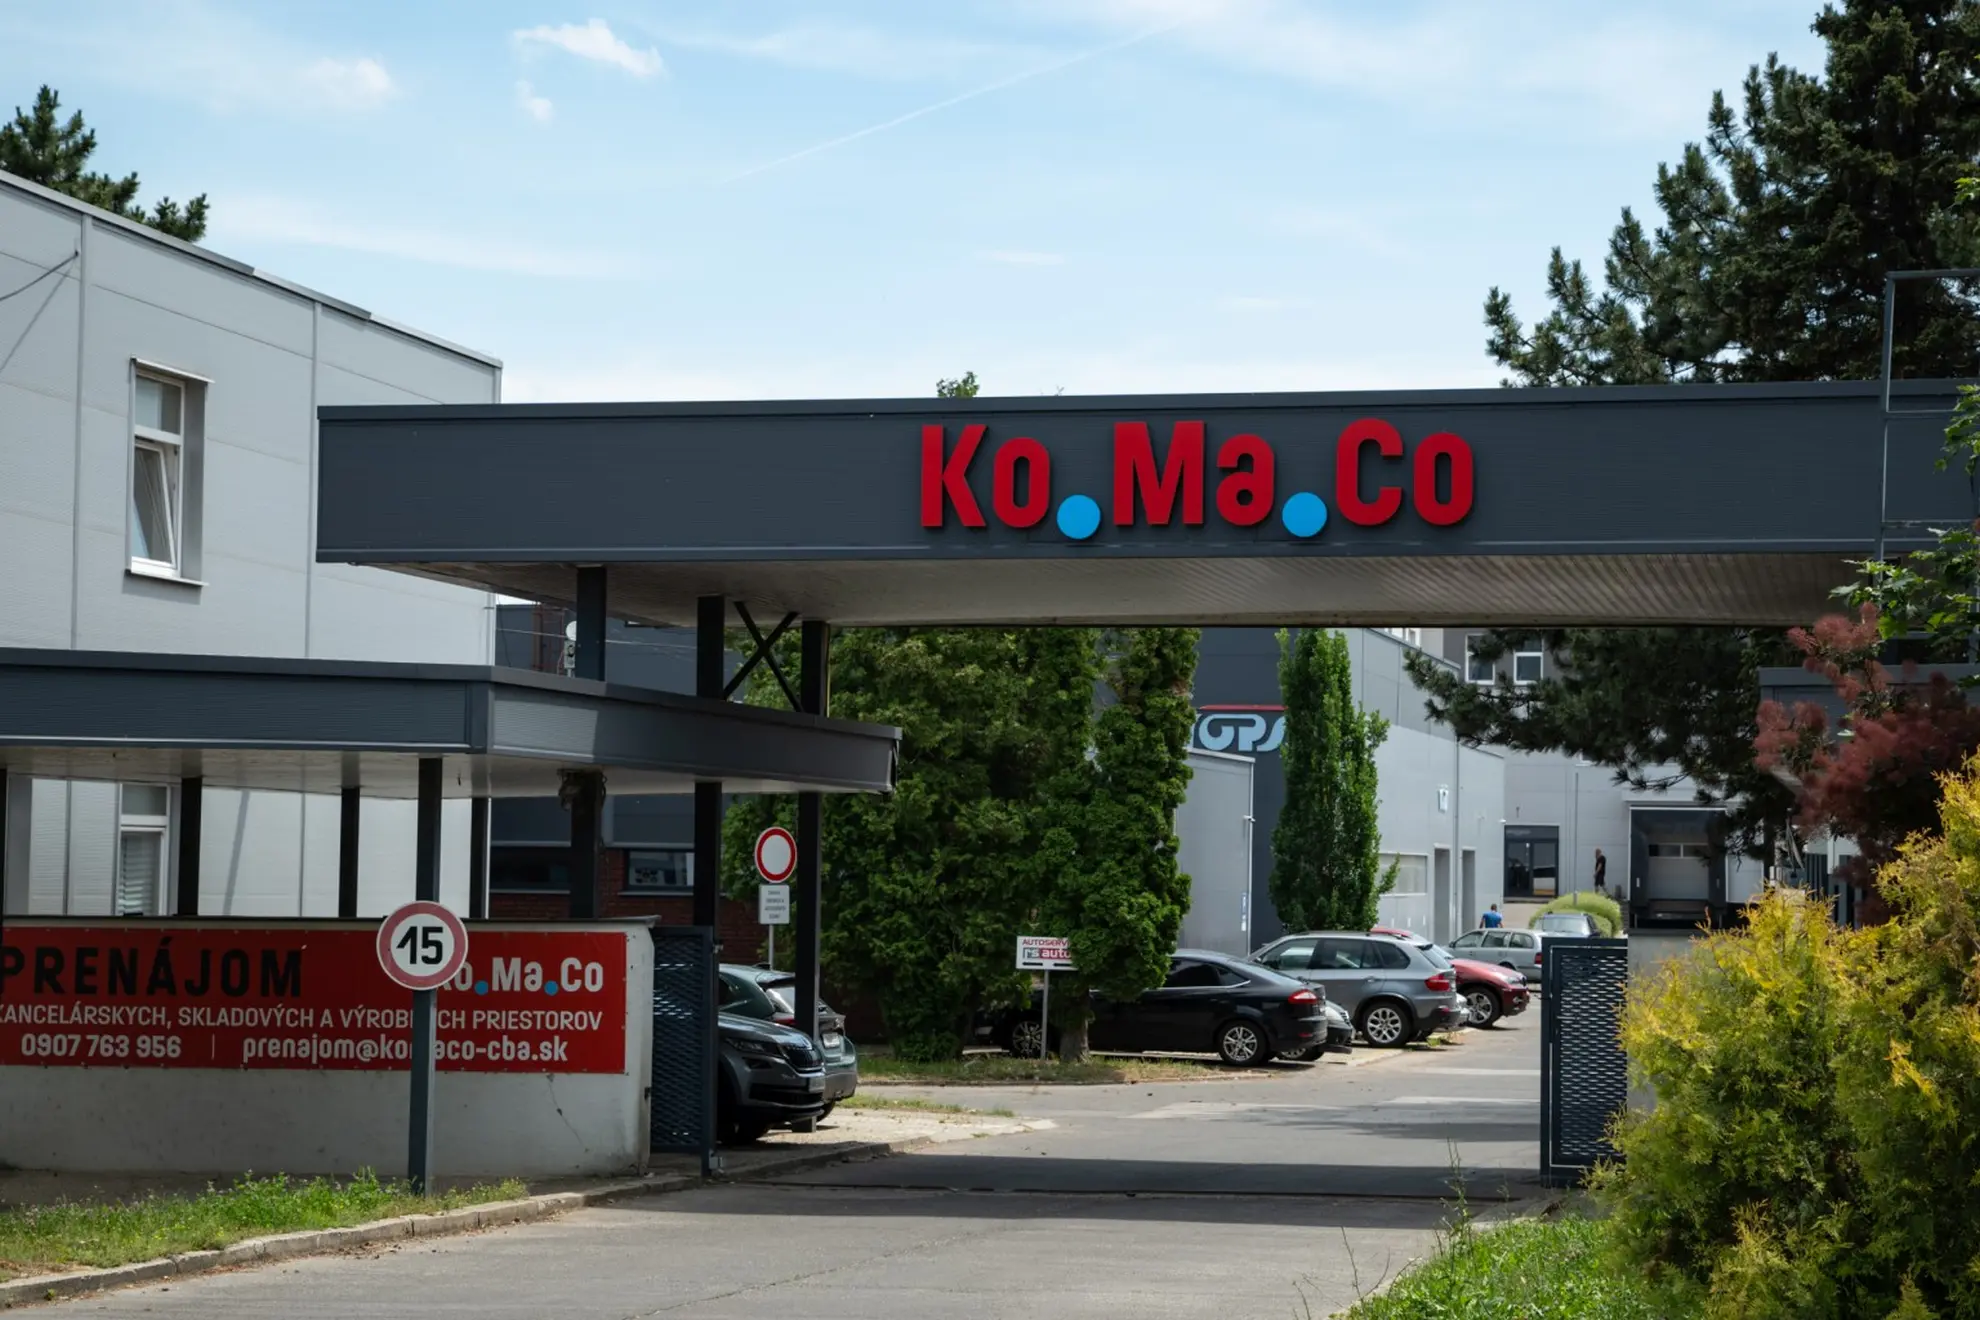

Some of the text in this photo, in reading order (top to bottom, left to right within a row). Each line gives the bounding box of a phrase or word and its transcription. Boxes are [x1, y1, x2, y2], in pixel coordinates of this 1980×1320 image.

[921, 418, 1474, 540] Ko.Ma.Co
[396, 926, 443, 965] 15
[0, 937, 303, 998] PRENÁJOM
[440, 957, 604, 996] o.Ma.Co
[178, 1003, 314, 1028] SKLADOVÝCH
[320, 1008, 334, 1028] A
[339, 1004, 465, 1030] VÝROBCH
[472, 1010, 603, 1031] PRIESTOROV
[21, 1033, 568, 1064] 0907 763 956 prenajom@koaco-cba.sk
